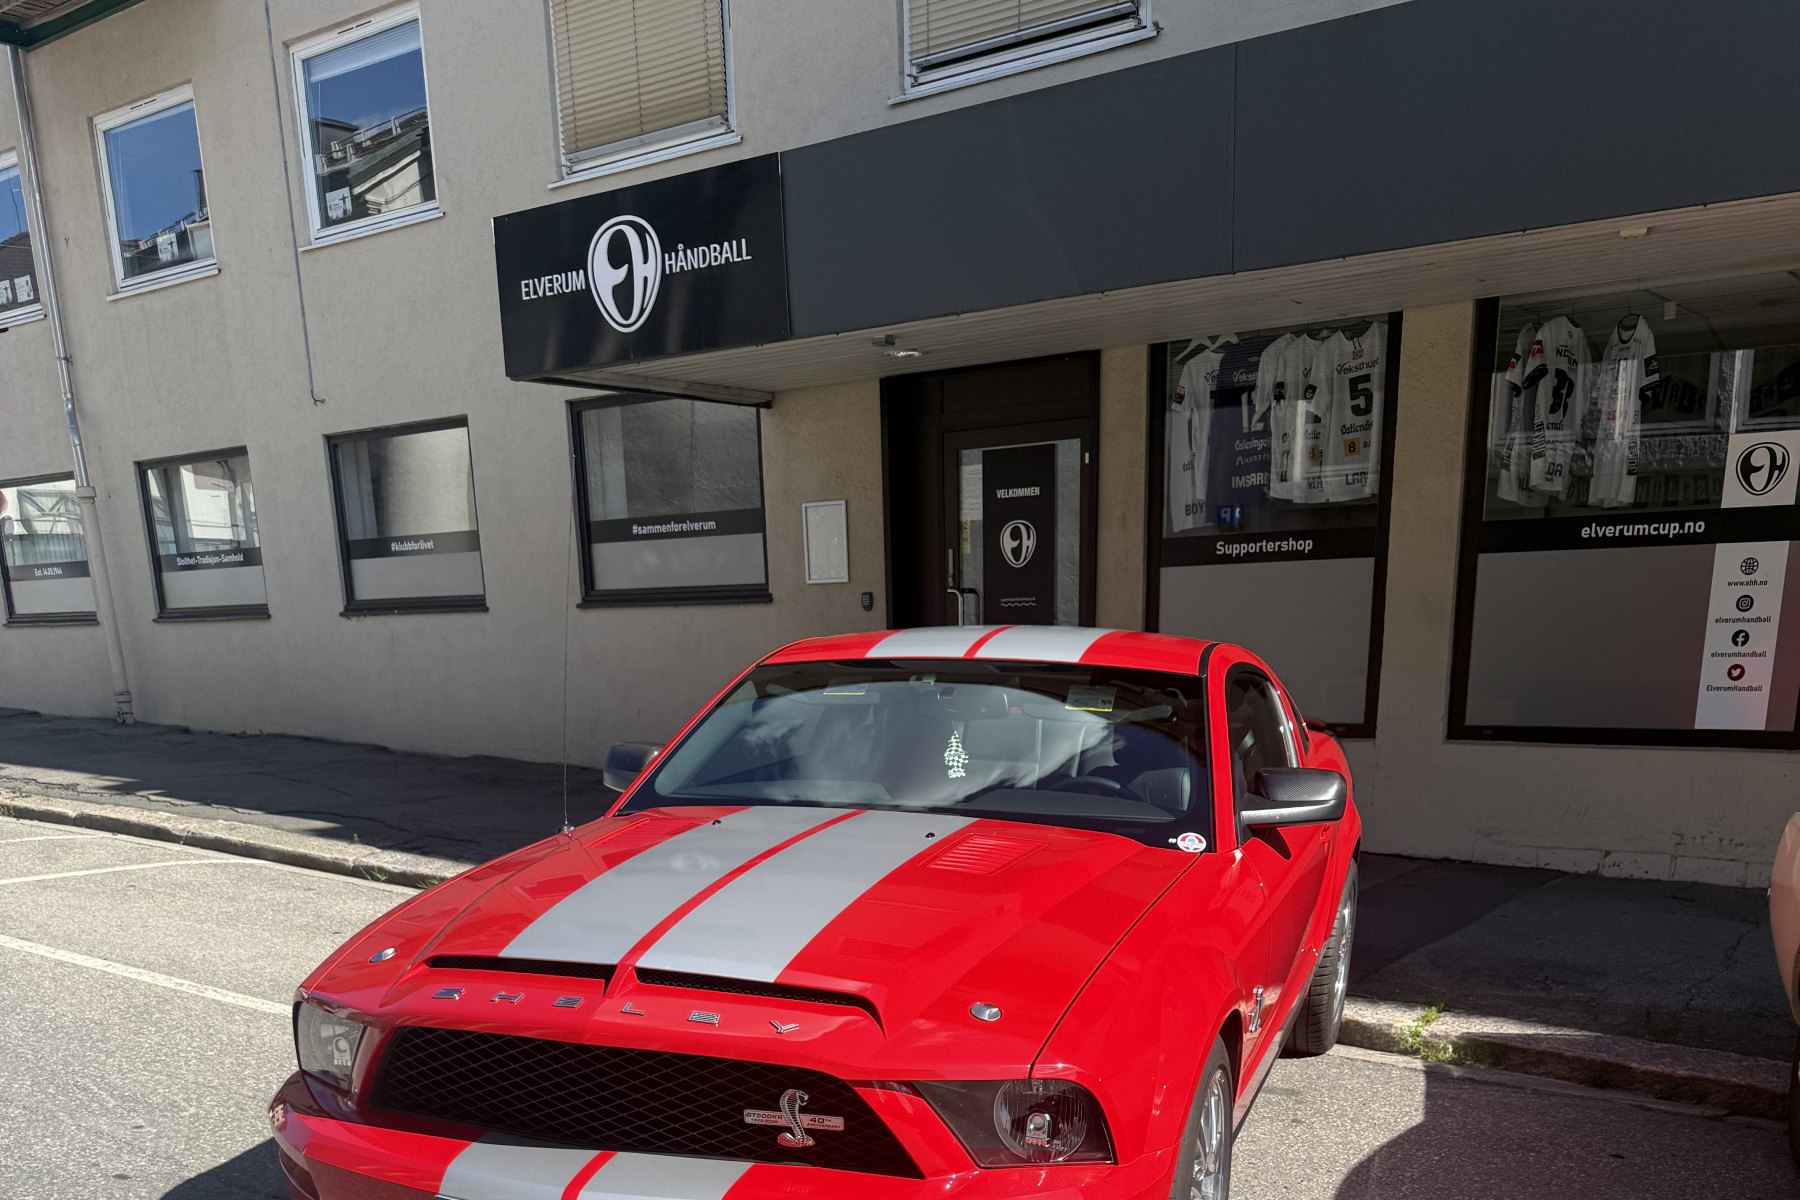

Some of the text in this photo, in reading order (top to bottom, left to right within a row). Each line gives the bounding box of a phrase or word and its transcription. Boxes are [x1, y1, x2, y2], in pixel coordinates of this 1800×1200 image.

[664, 238, 752, 274] HÅNDBALL
[521, 269, 586, 301] ELVERUM
[1349, 373, 1374, 417] 5
[996, 486, 1041, 499] VELKOMMEN
[632, 519, 717, 536] #sammenforelverum
[1580, 518, 1706, 540] elverumcup.no
[1215, 536, 1314, 557] Supportershop
[1727, 579, 1768, 587] www.ehh.no
[1714, 616, 1771, 624] elverumhandball
[1710, 650, 1767, 658] elverumhandball
[1706, 684, 1763, 692] ElverumHandball
[432, 987, 800, 1035] SHELBY
